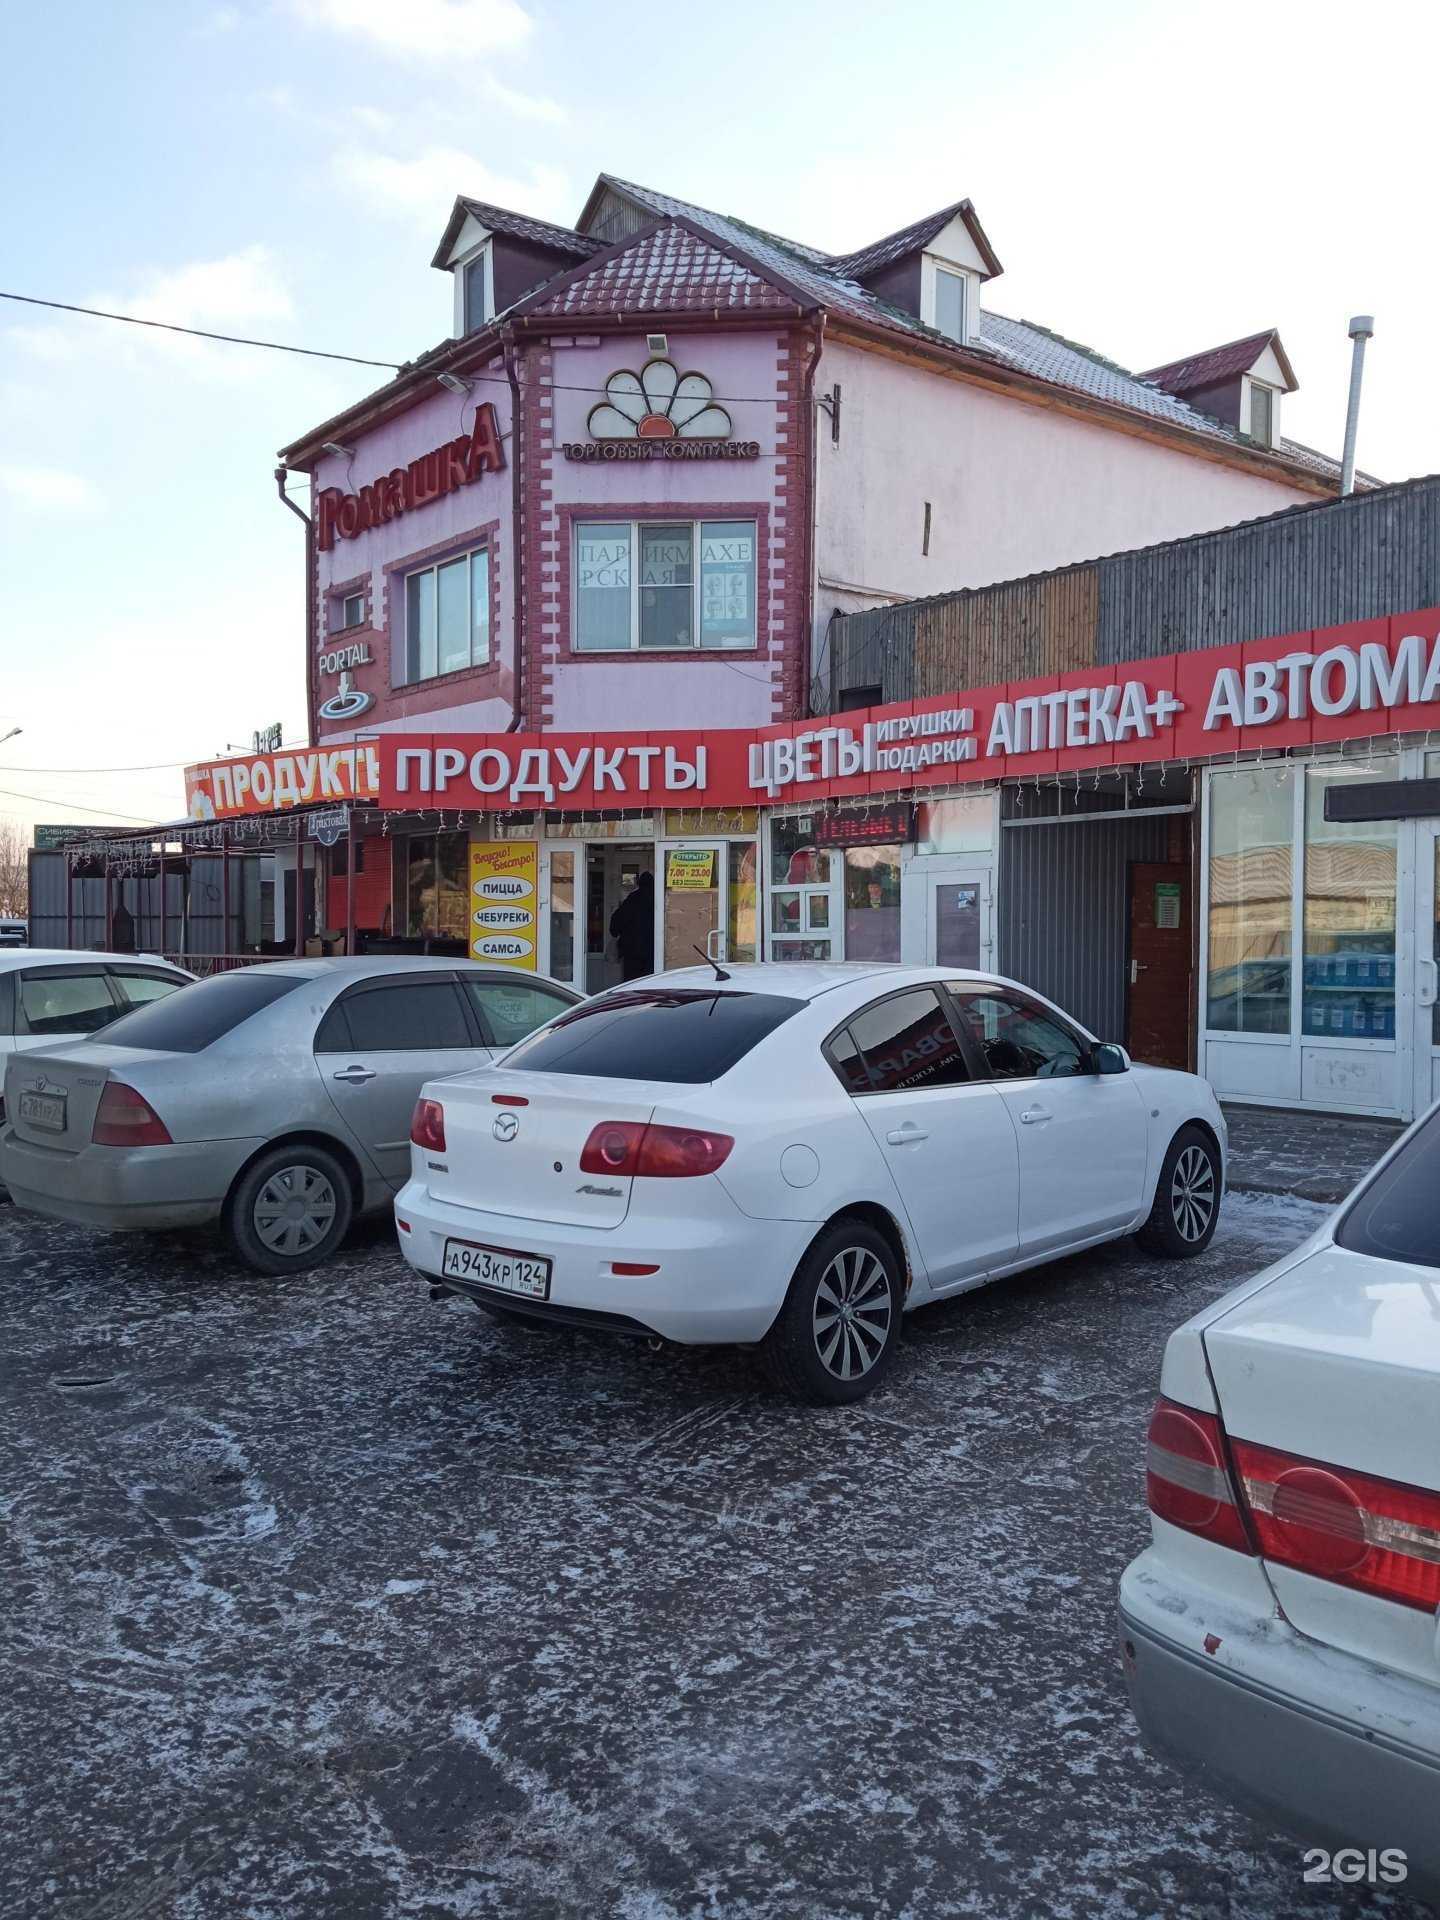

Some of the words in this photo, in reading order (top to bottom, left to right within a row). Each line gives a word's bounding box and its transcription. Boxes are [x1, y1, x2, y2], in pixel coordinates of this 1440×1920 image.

[563, 442, 655, 462] ТОРГОВЫЙ
[662, 441, 761, 461] КОМПЛЕКС
[319, 643, 374, 676] PORTAL
[877, 708, 974, 742] ИГРУШКИ
[396, 746, 708, 803] ПРОДУКТЫ
[748, 723, 877, 798] ЦВЕТЫ
[877, 737, 978, 773] ПОДАРКИ
[473, 846, 511, 865] Вкусно!
[491, 852, 535, 872] Быстро!
[483, 884, 523, 896] ПИЦЦА
[477, 912, 529, 923] ЧЕБУРЕКИ
[483, 944, 522, 954] САМСА
